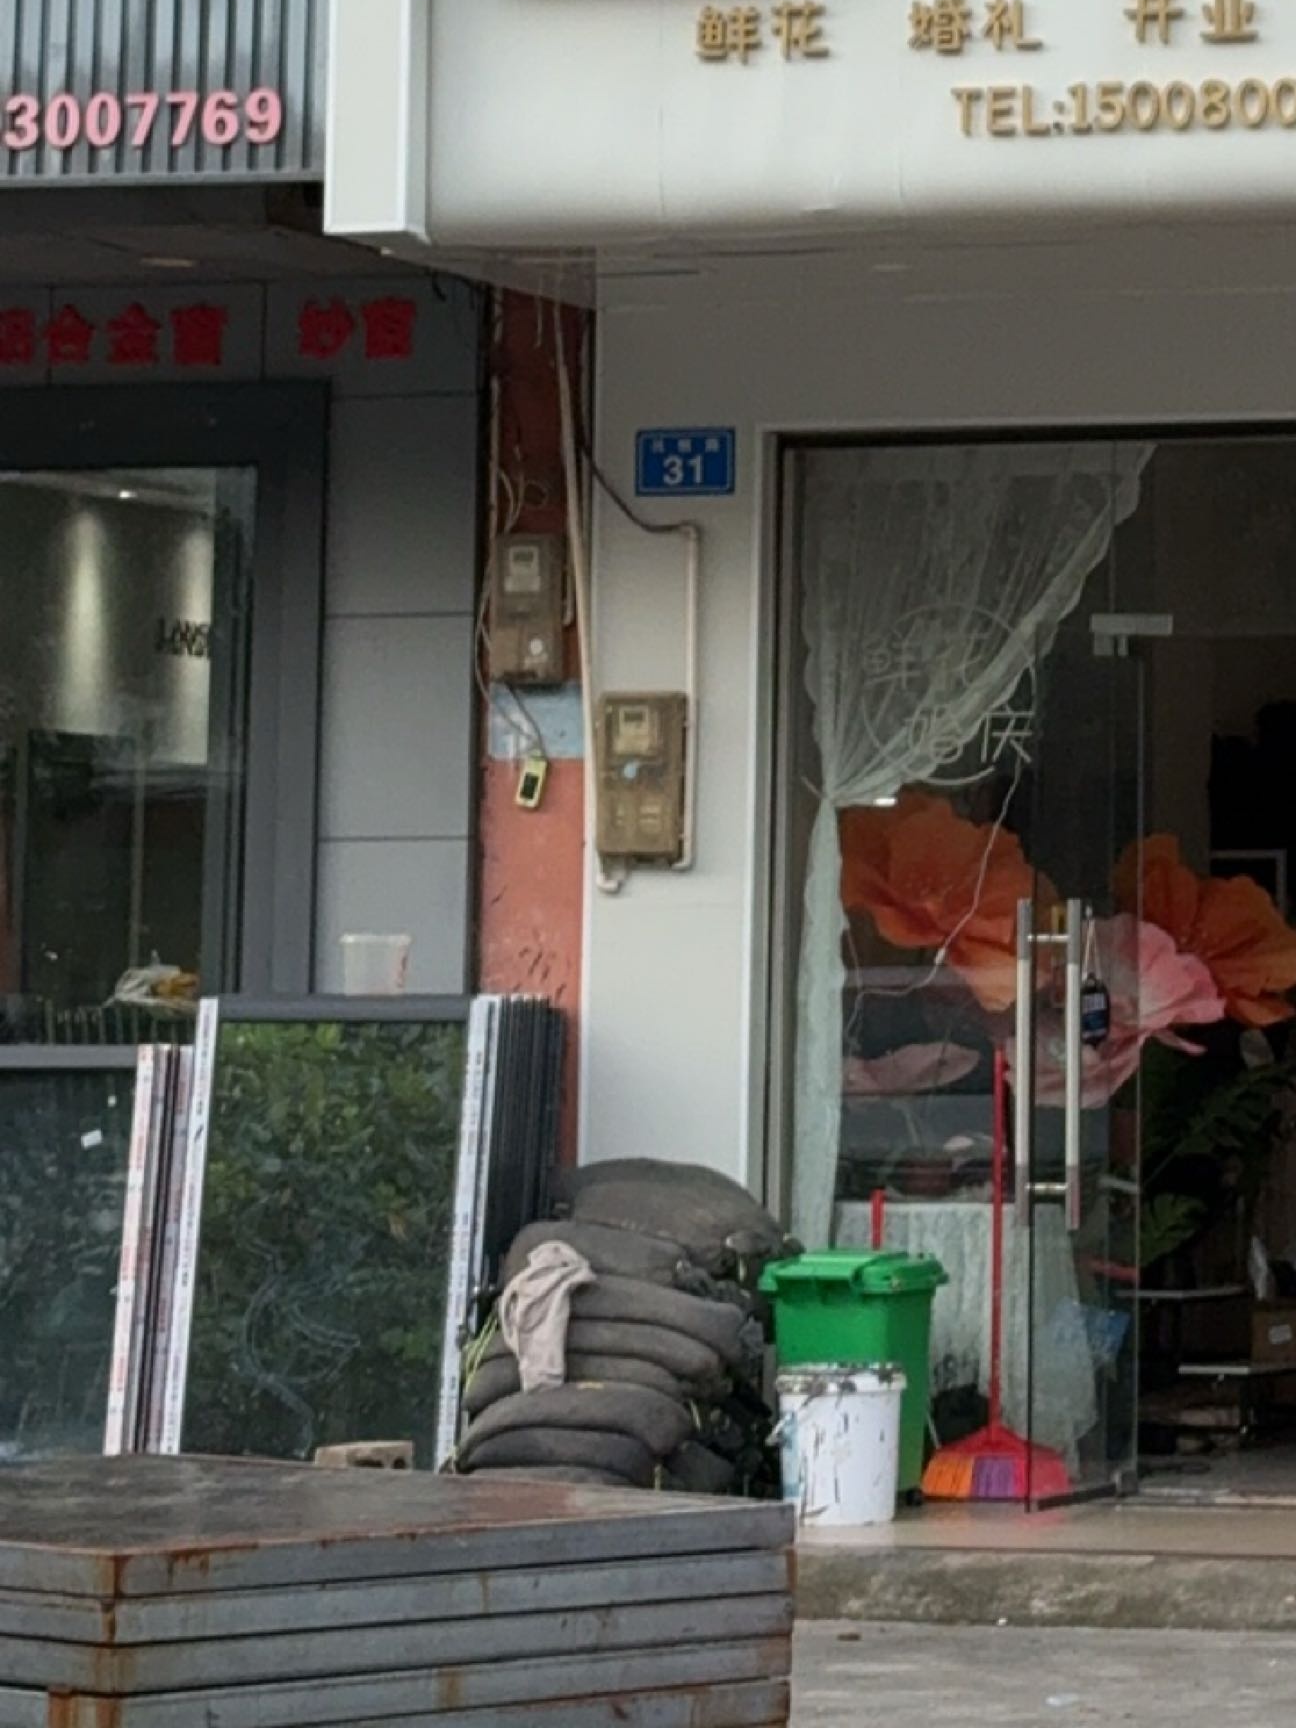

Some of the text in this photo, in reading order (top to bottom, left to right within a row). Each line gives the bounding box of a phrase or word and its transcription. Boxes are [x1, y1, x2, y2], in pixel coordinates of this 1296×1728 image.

[697, 0, 831, 63] 鲜花
[3, 87, 283, 151] 3007769
[662, 454, 704, 486] 31
